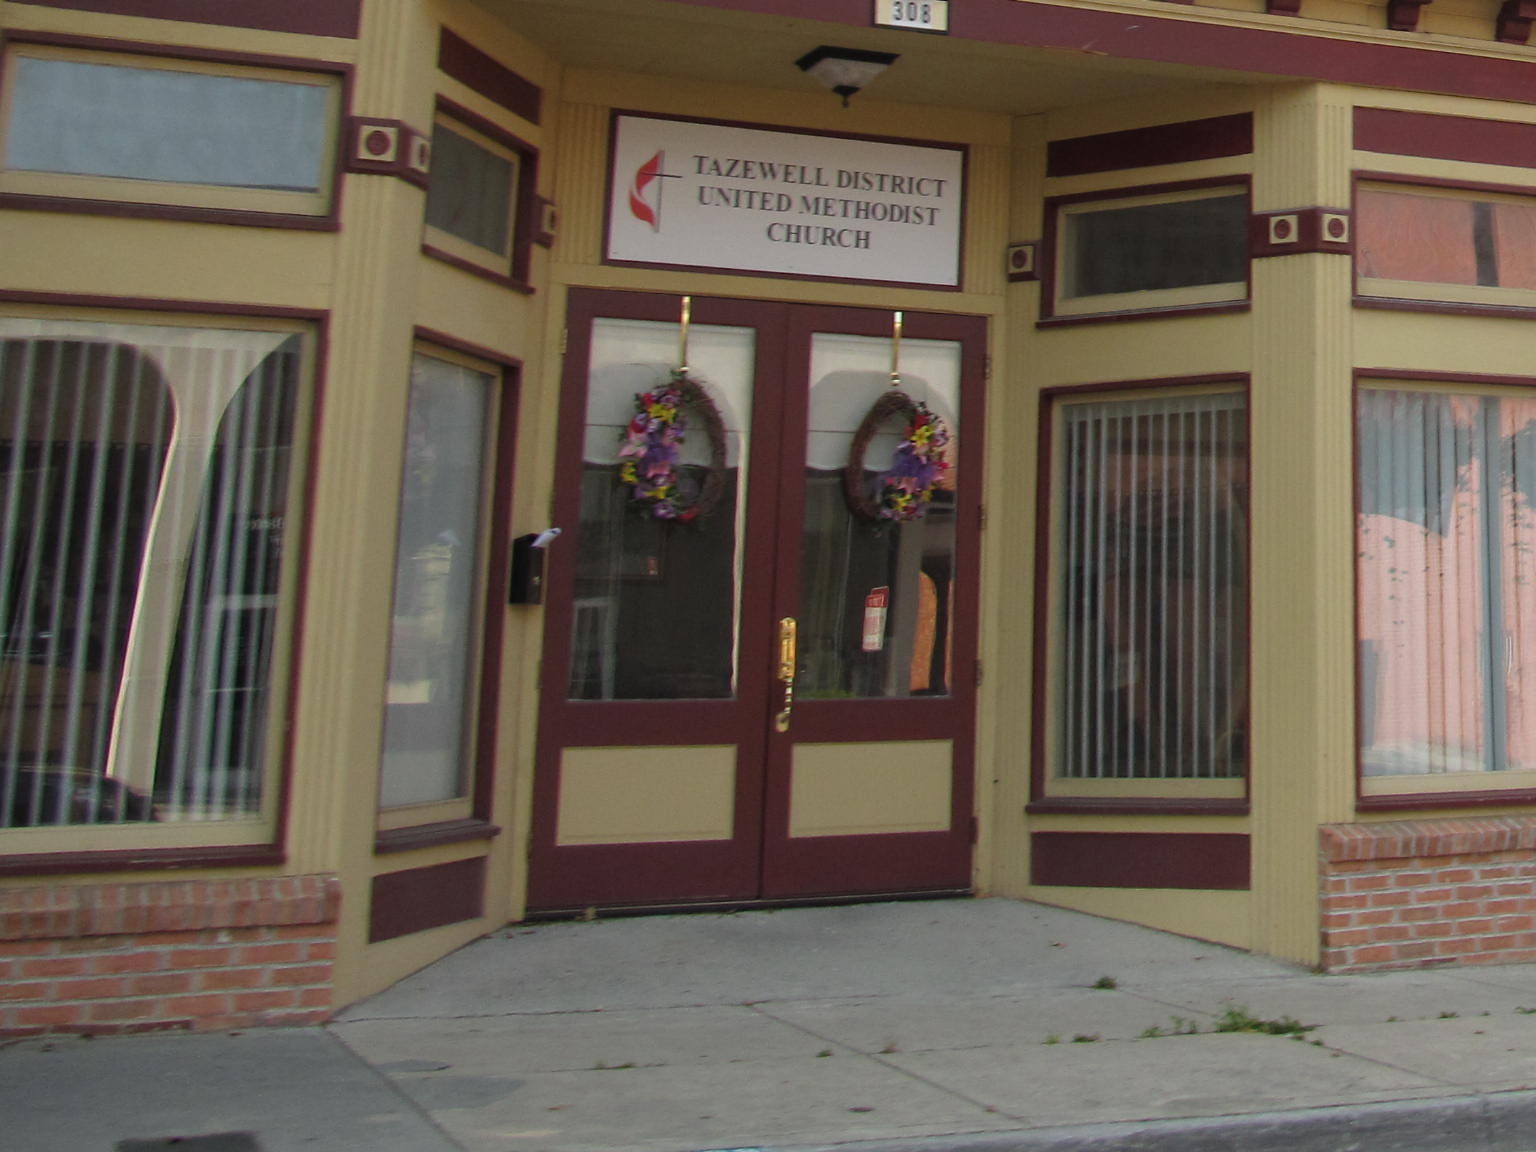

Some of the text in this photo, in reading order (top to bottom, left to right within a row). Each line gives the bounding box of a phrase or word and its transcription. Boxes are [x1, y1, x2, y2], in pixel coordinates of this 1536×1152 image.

[892, 0, 932, 24] 308
[693, 155, 947, 198] TAZEWELL DISTRICT
[698, 186, 940, 226] UNITED METHODIST
[766, 222, 872, 249] CHURCH
